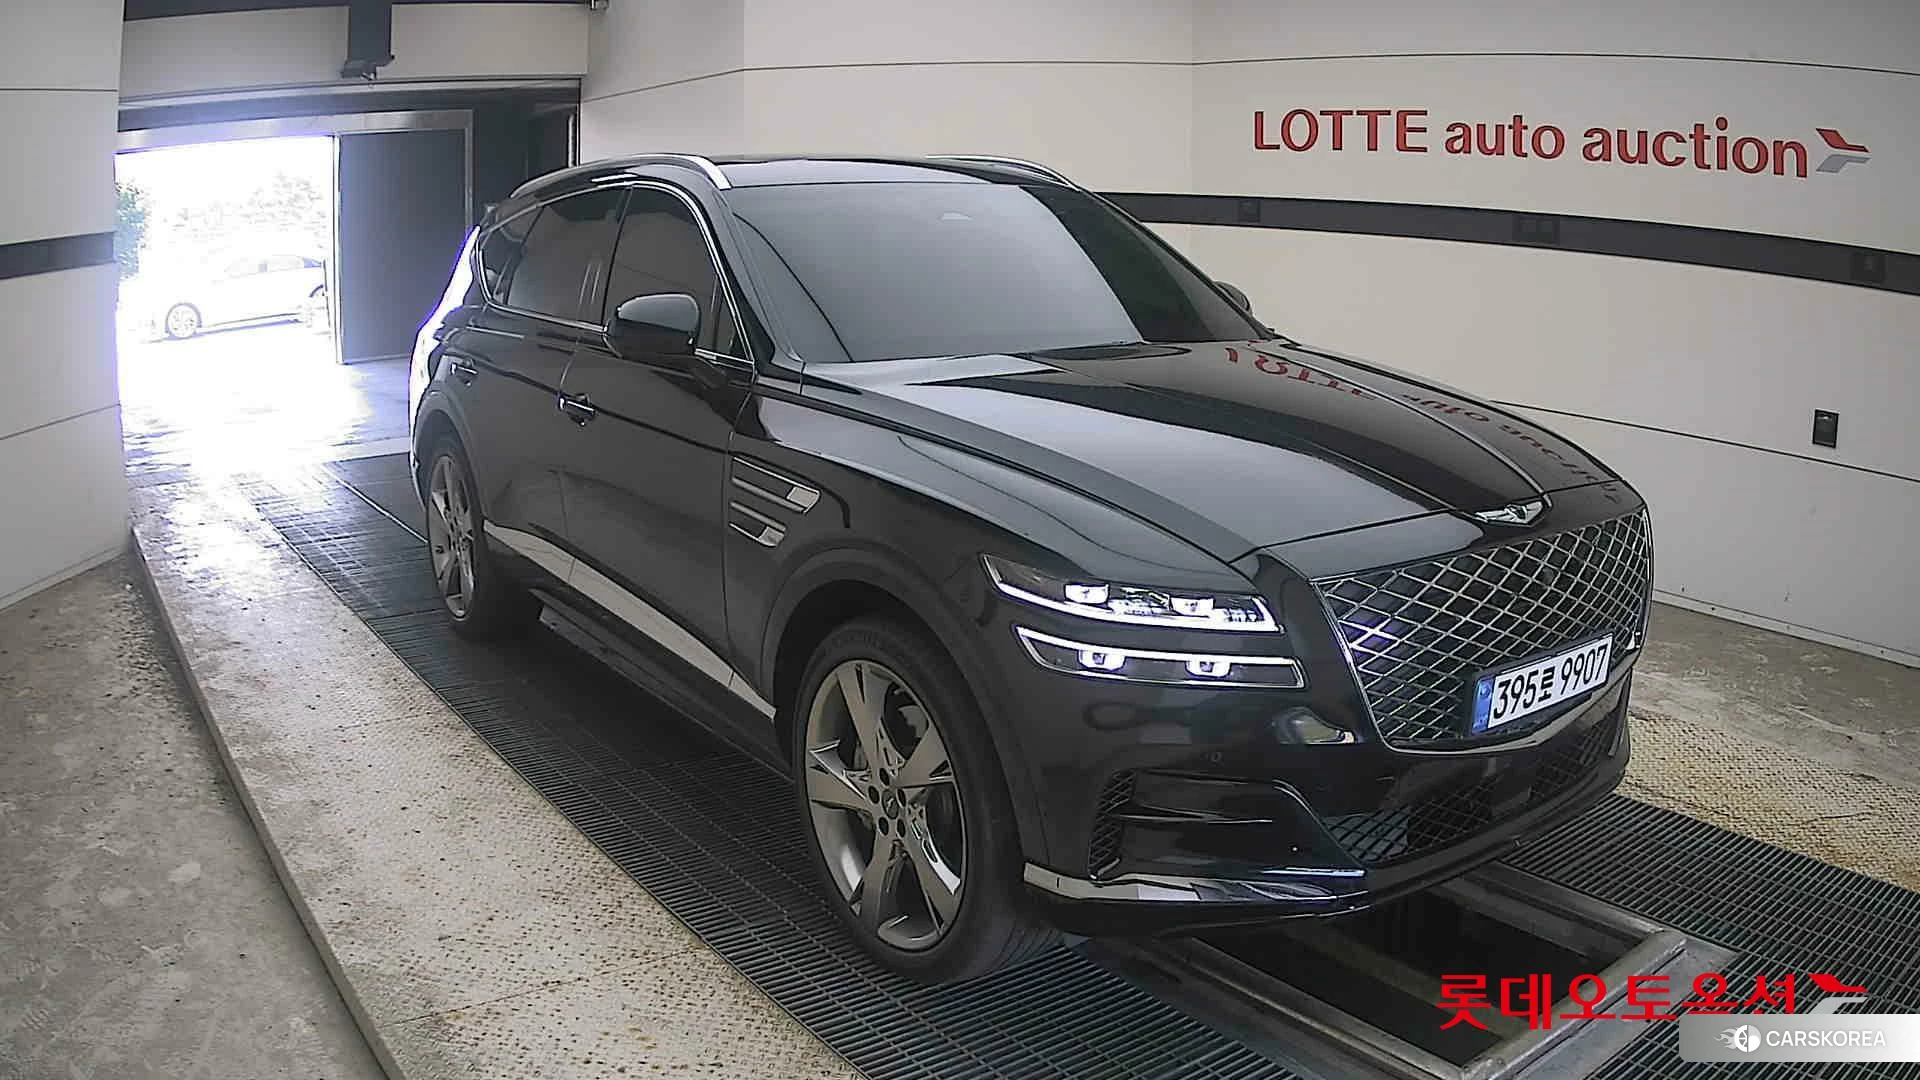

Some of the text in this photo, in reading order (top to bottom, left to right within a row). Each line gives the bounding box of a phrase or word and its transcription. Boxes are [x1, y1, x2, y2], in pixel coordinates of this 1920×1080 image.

[1254, 110, 1808, 178] LOTTE auto auction
[1560, 645, 1608, 696] 9907
